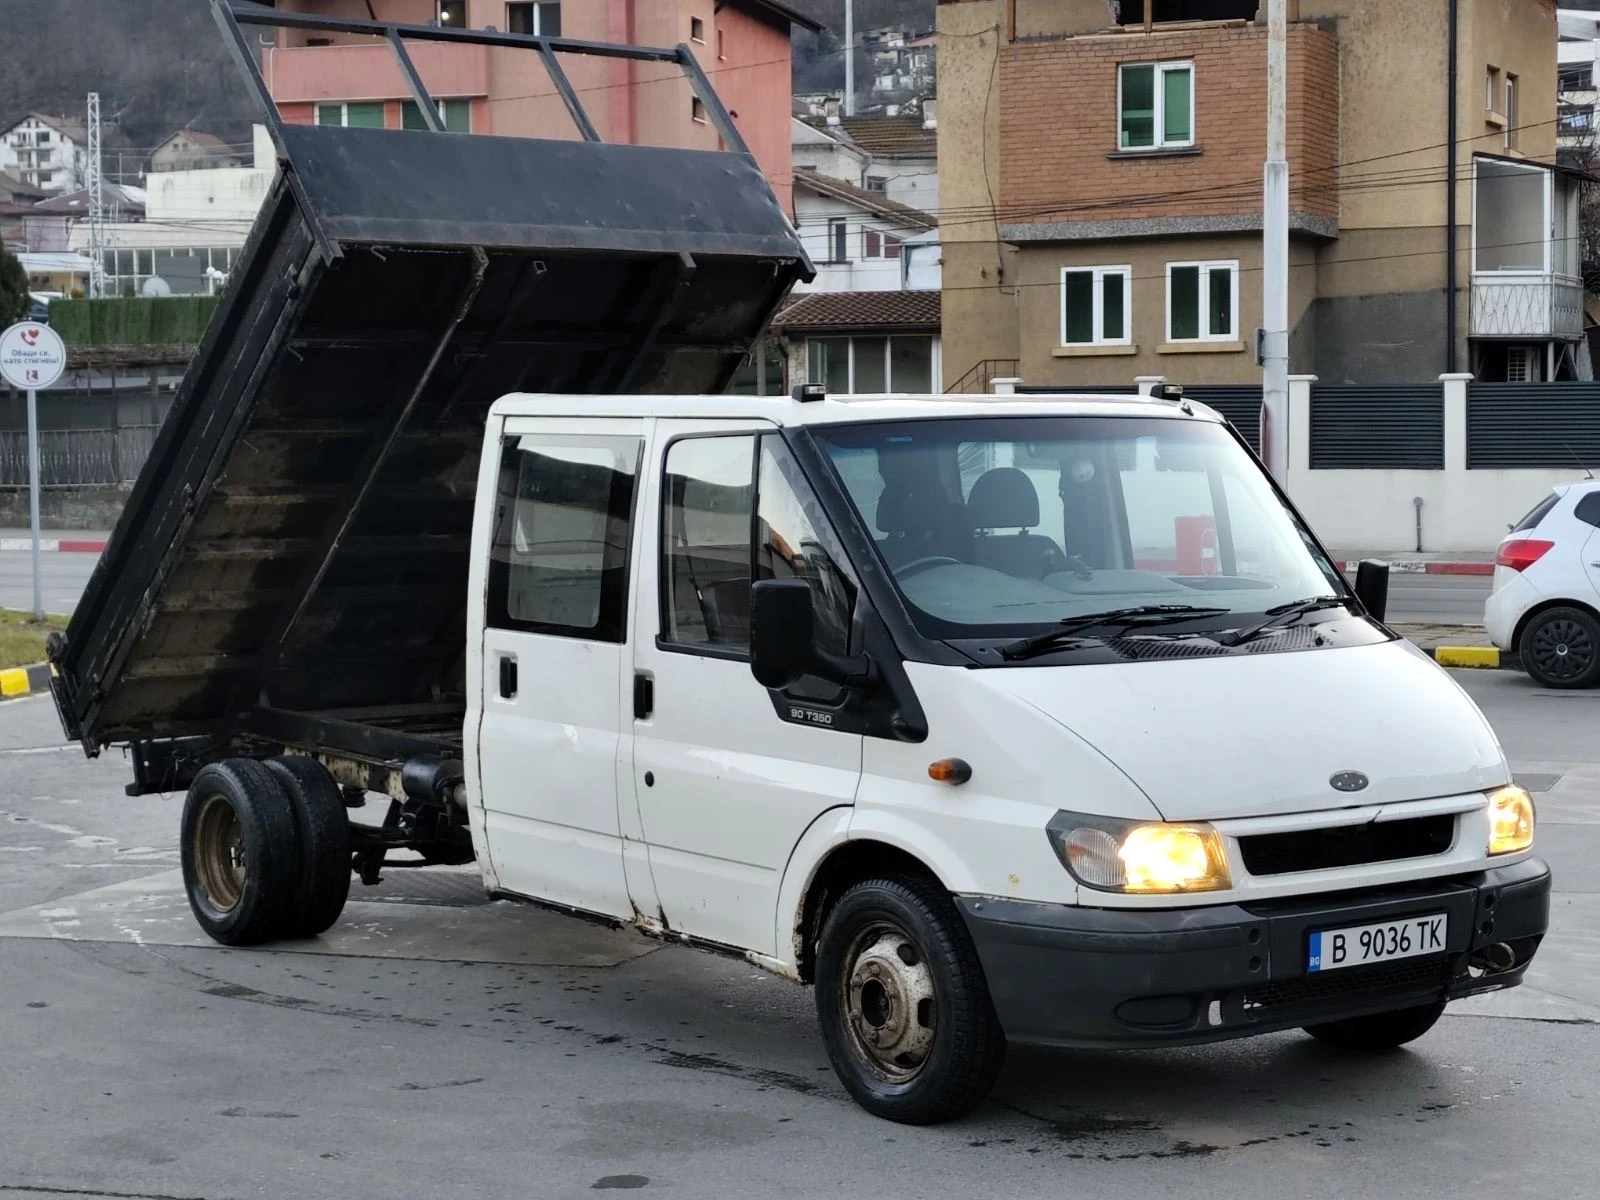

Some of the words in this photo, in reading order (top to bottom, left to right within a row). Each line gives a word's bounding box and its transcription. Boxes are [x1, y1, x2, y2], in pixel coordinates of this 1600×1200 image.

[11, 349, 37, 357] Обади
[791, 709, 804, 719] 90
[806, 711, 832, 724] T350
[1332, 933, 1347, 964] B
[1360, 923, 1412, 960] 9036
[1416, 918, 1442, 950] TK
[1309, 956, 1320, 967] BG
